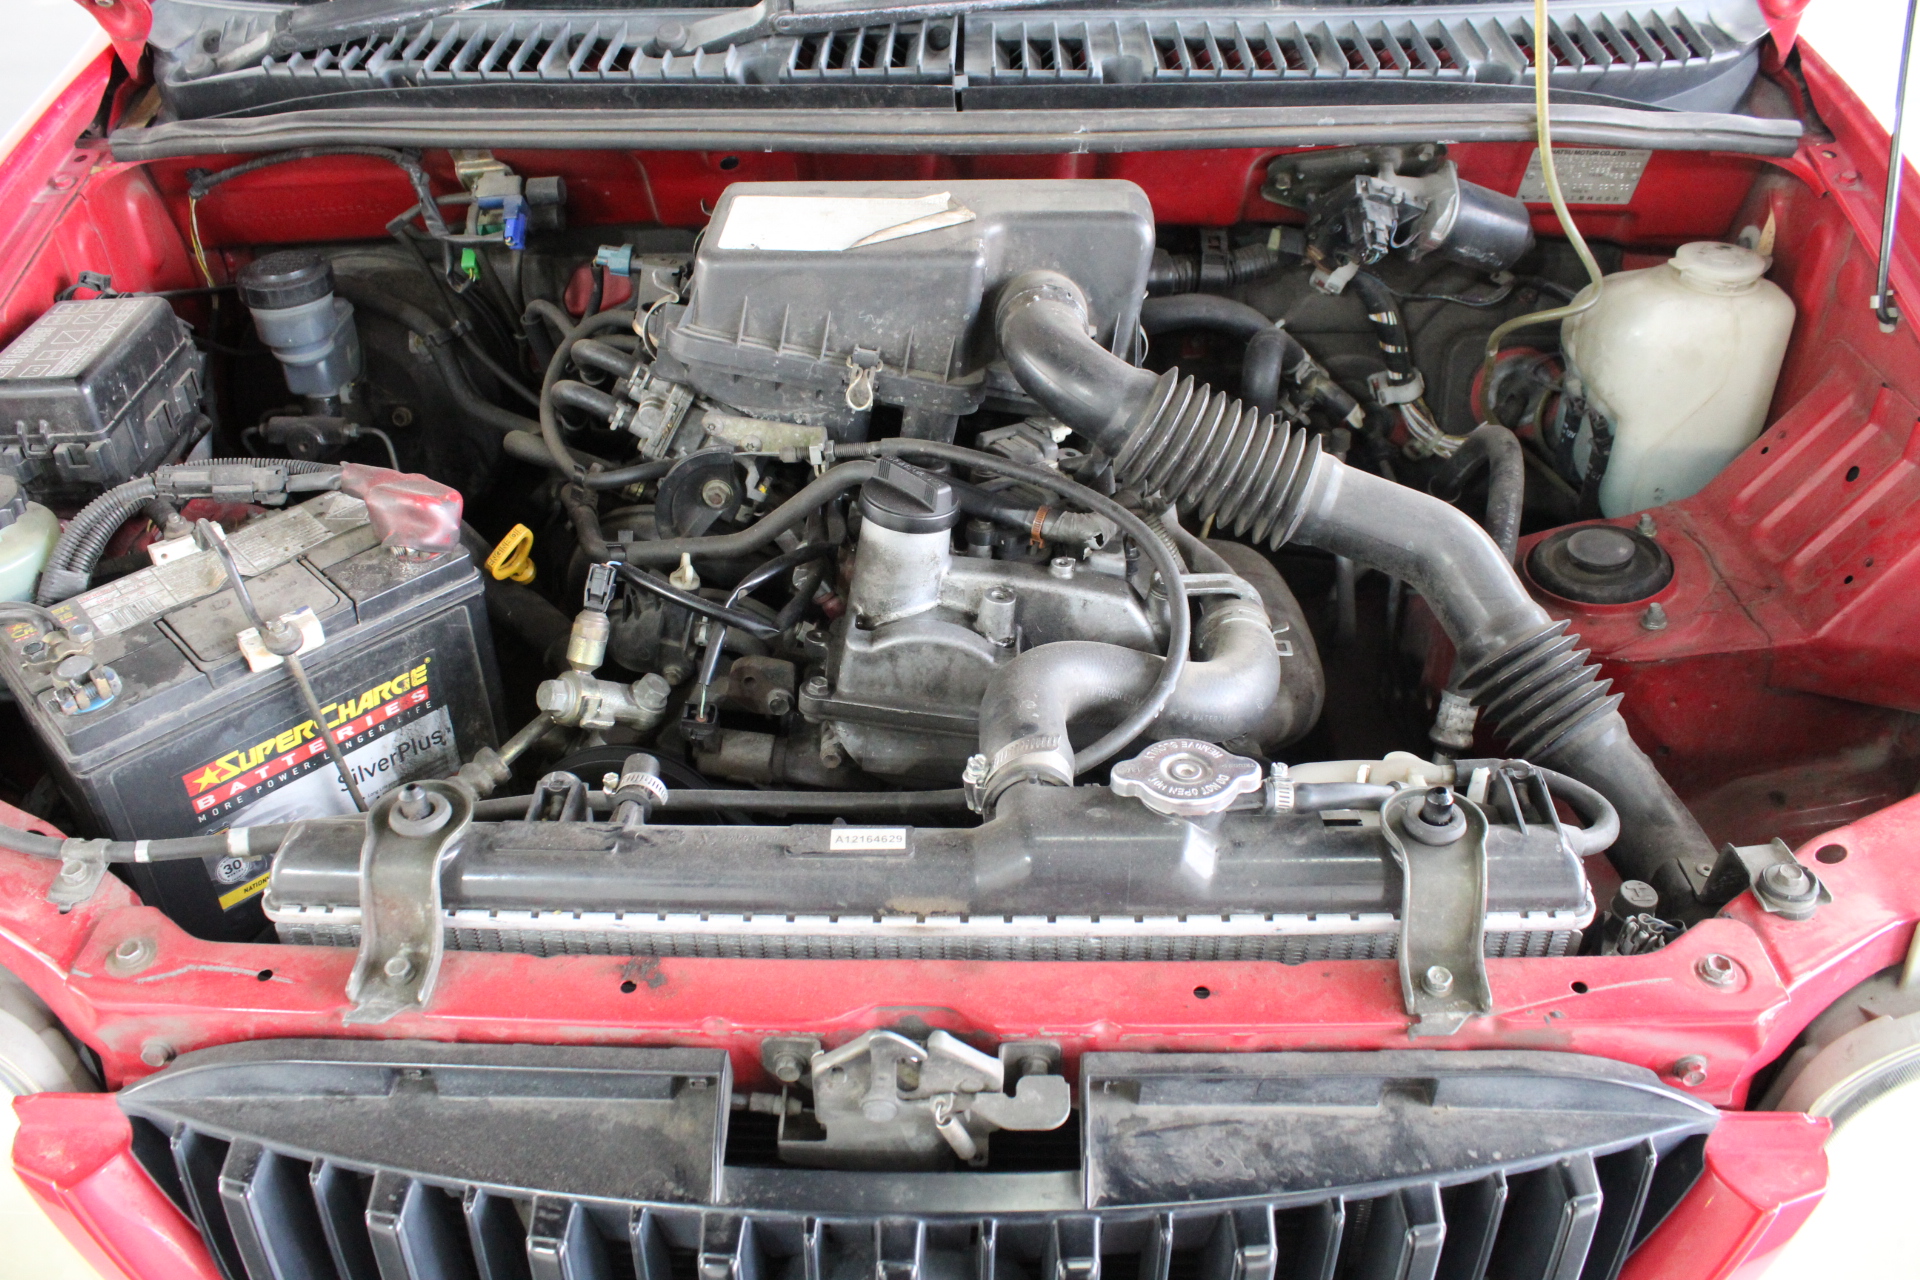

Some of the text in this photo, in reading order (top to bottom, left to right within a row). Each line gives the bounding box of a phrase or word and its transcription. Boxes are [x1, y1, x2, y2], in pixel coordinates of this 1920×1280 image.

[196, 690, 426, 810] BATTERIES
[198, 701, 432, 823] MORE POWER. LNGER LIFE
[1147, 774, 1231, 797] DO NOT OPEN HOT
[835, 834, 903, 844] A12164629
[223, 859, 242, 876] 30
